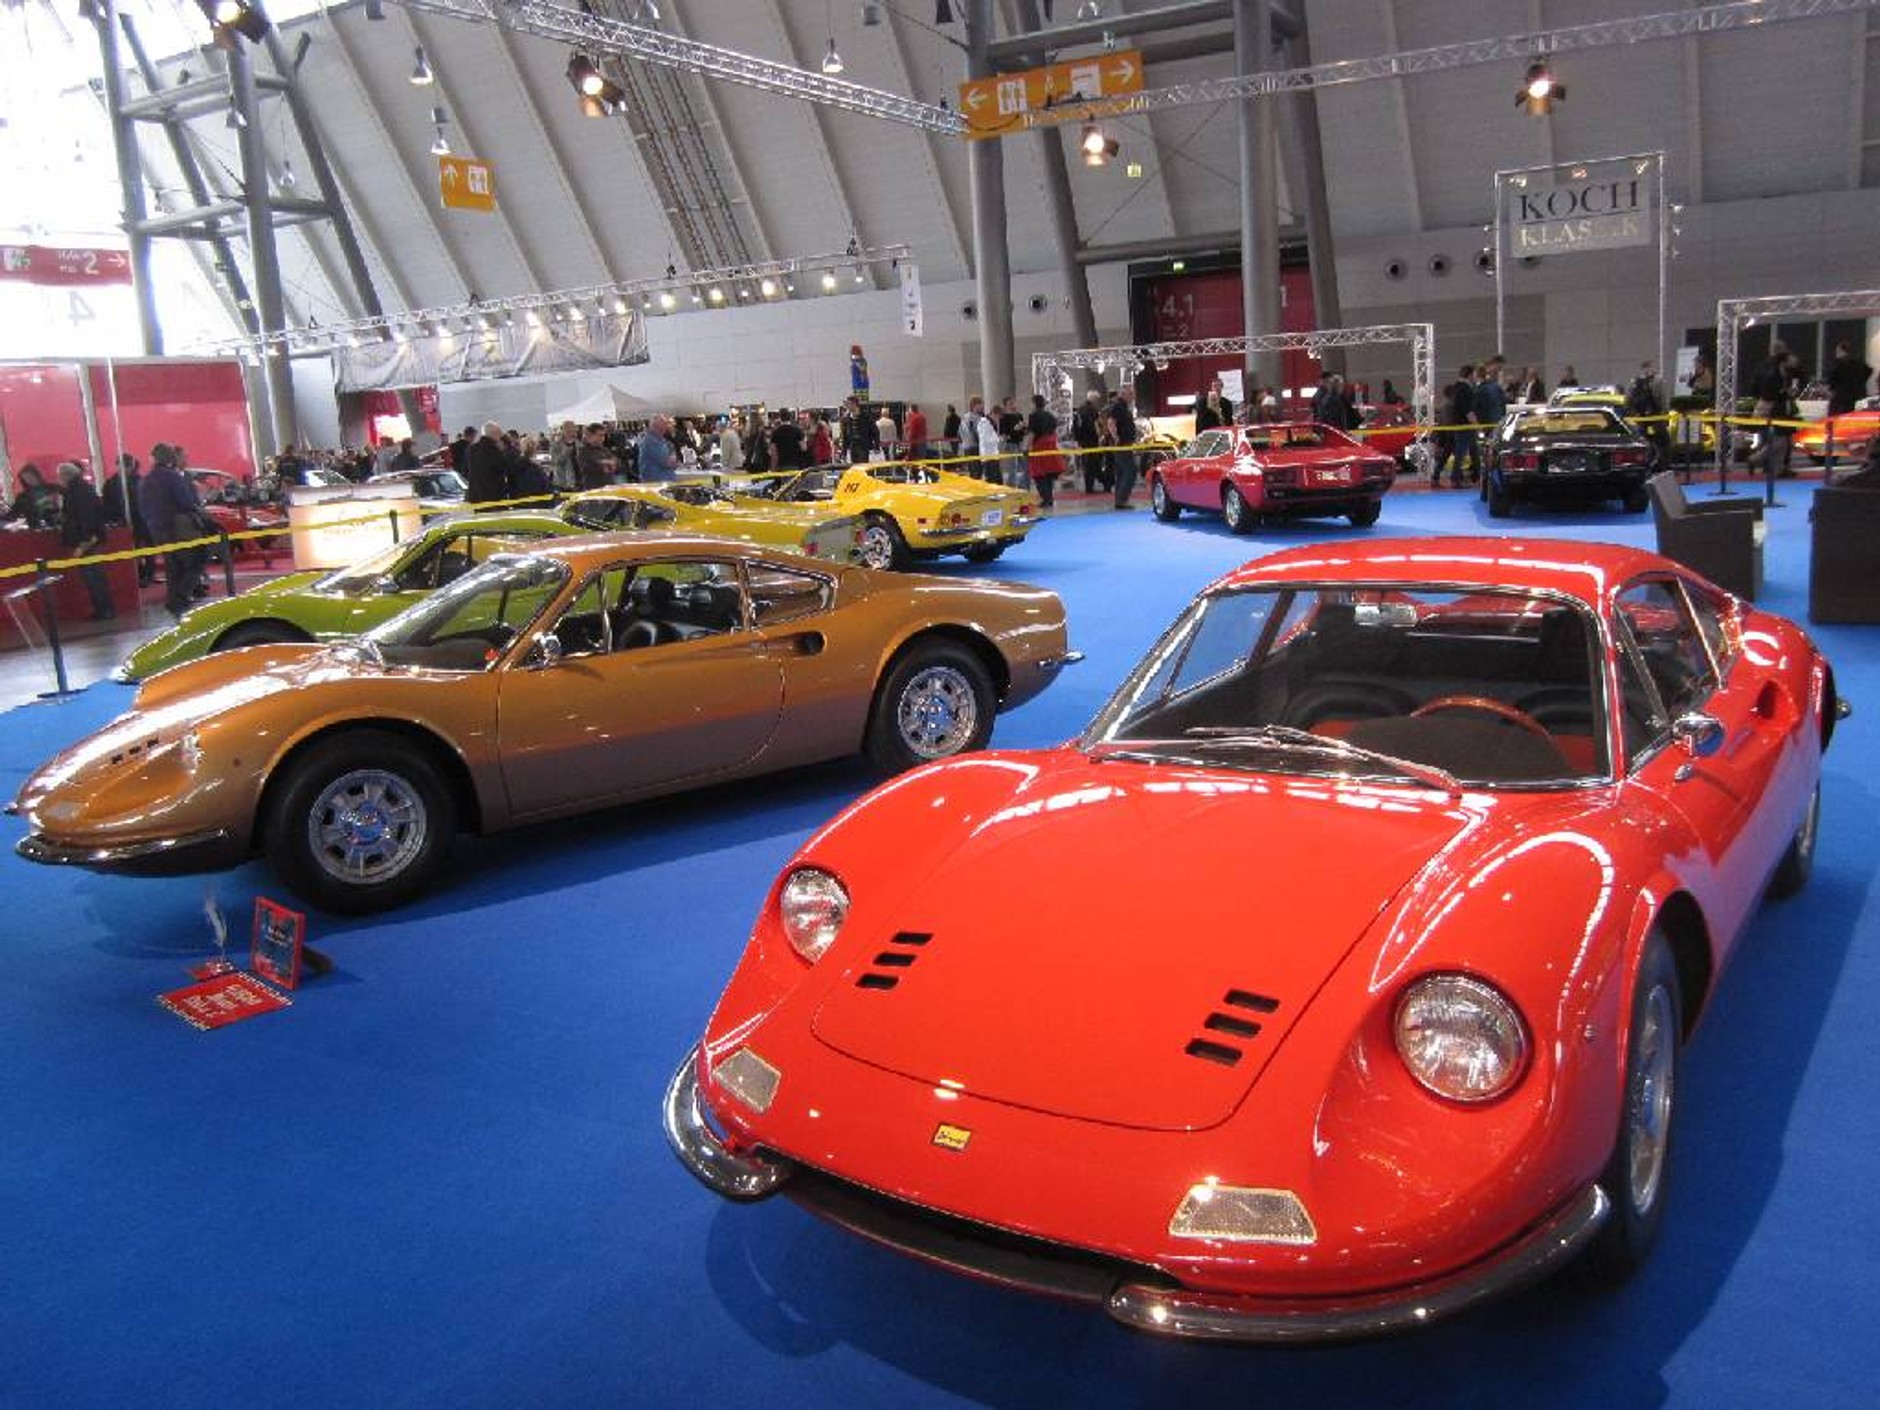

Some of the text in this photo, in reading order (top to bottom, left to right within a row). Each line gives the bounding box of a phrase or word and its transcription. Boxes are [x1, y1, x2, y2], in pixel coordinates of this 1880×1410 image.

[1517, 179, 1640, 221] KOCH
[83, 251, 99, 275] 2
[1161, 293, 1193, 317] 4.1
